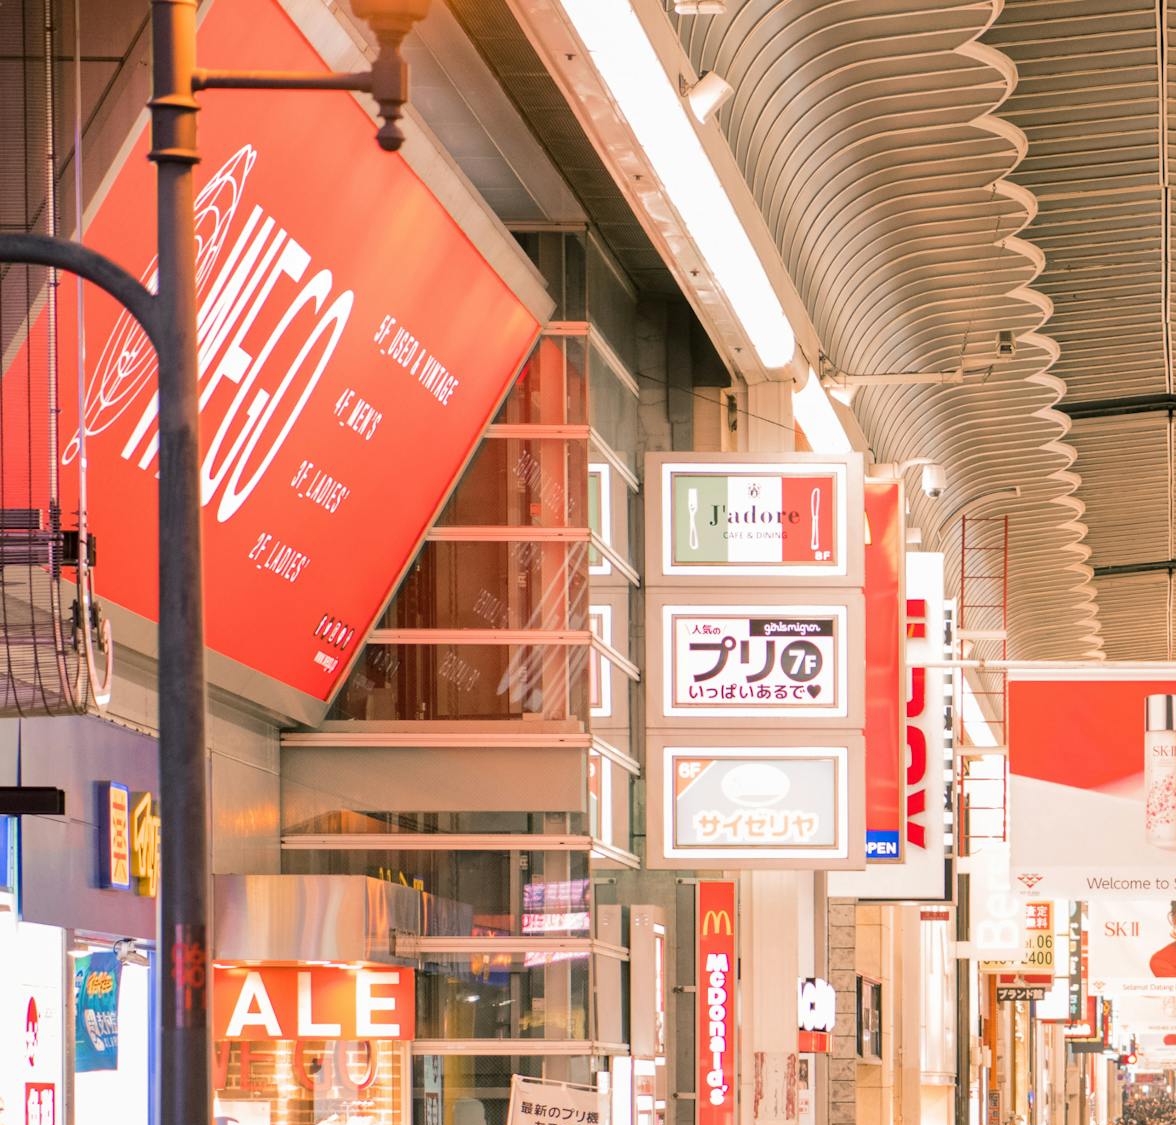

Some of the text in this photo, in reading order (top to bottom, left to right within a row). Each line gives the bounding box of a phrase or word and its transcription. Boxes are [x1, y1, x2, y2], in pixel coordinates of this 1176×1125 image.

[418, 355, 459, 406] VINTAGE
[709, 504, 800, 526] J'adore
[756, 531, 788, 539] DINING
[689, 636, 775, 683] プリ
[789, 649, 817, 675] 7F
[689, 683, 806, 700] いっぱいあるで
[678, 762, 701, 779] 6F
[865, 842, 897, 855] PEN
[1087, 876, 1151, 890] Welcome
[1156, 877, 1169, 890] to
[225, 971, 400, 1037] ALE
[706, 953, 730, 1106] McDonald's
[521, 1101, 600, 1125] 最新のプリ機
